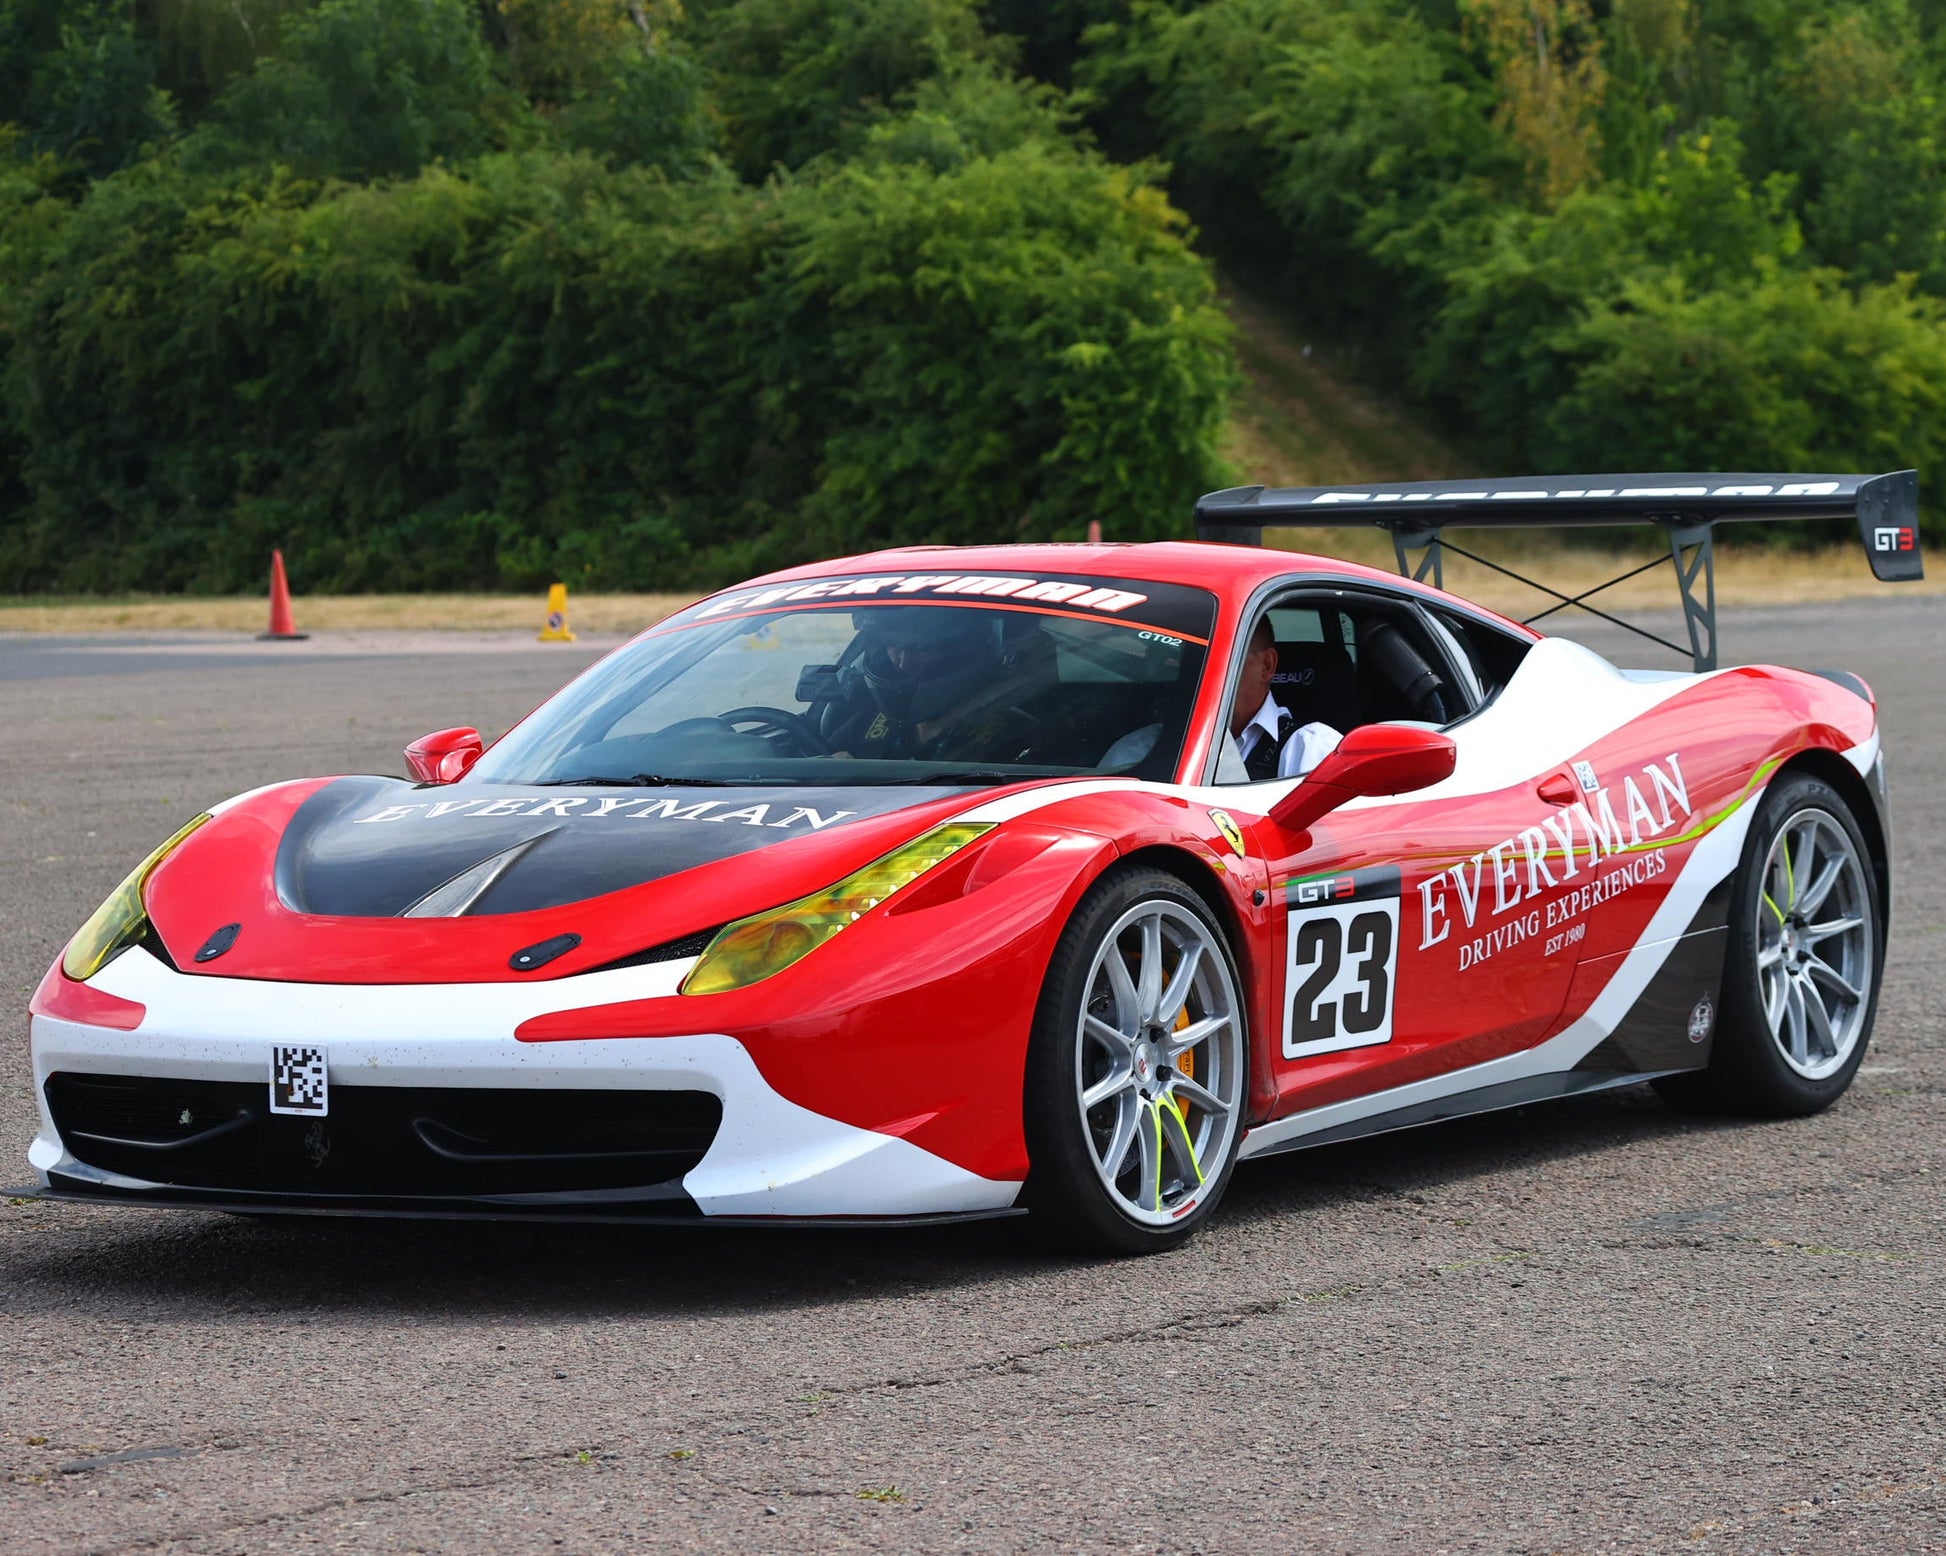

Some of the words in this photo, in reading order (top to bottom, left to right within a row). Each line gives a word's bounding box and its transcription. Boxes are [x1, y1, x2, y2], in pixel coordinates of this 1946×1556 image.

[1874, 527, 1914, 551] GT3
[695, 575, 1148, 620] EVERYMAN
[353, 798, 858, 831] EVERYMAN
[1416, 752, 1692, 952] EVERYMAN
[1298, 877, 1355, 903] GT3
[1458, 907, 1540, 972] DRIVING
[1545, 848, 1666, 929] EXPERIENCES
[1544, 933, 1565, 957] EST
[1564, 922, 1586, 947] 1980
[1291, 910, 1392, 1045] 23
